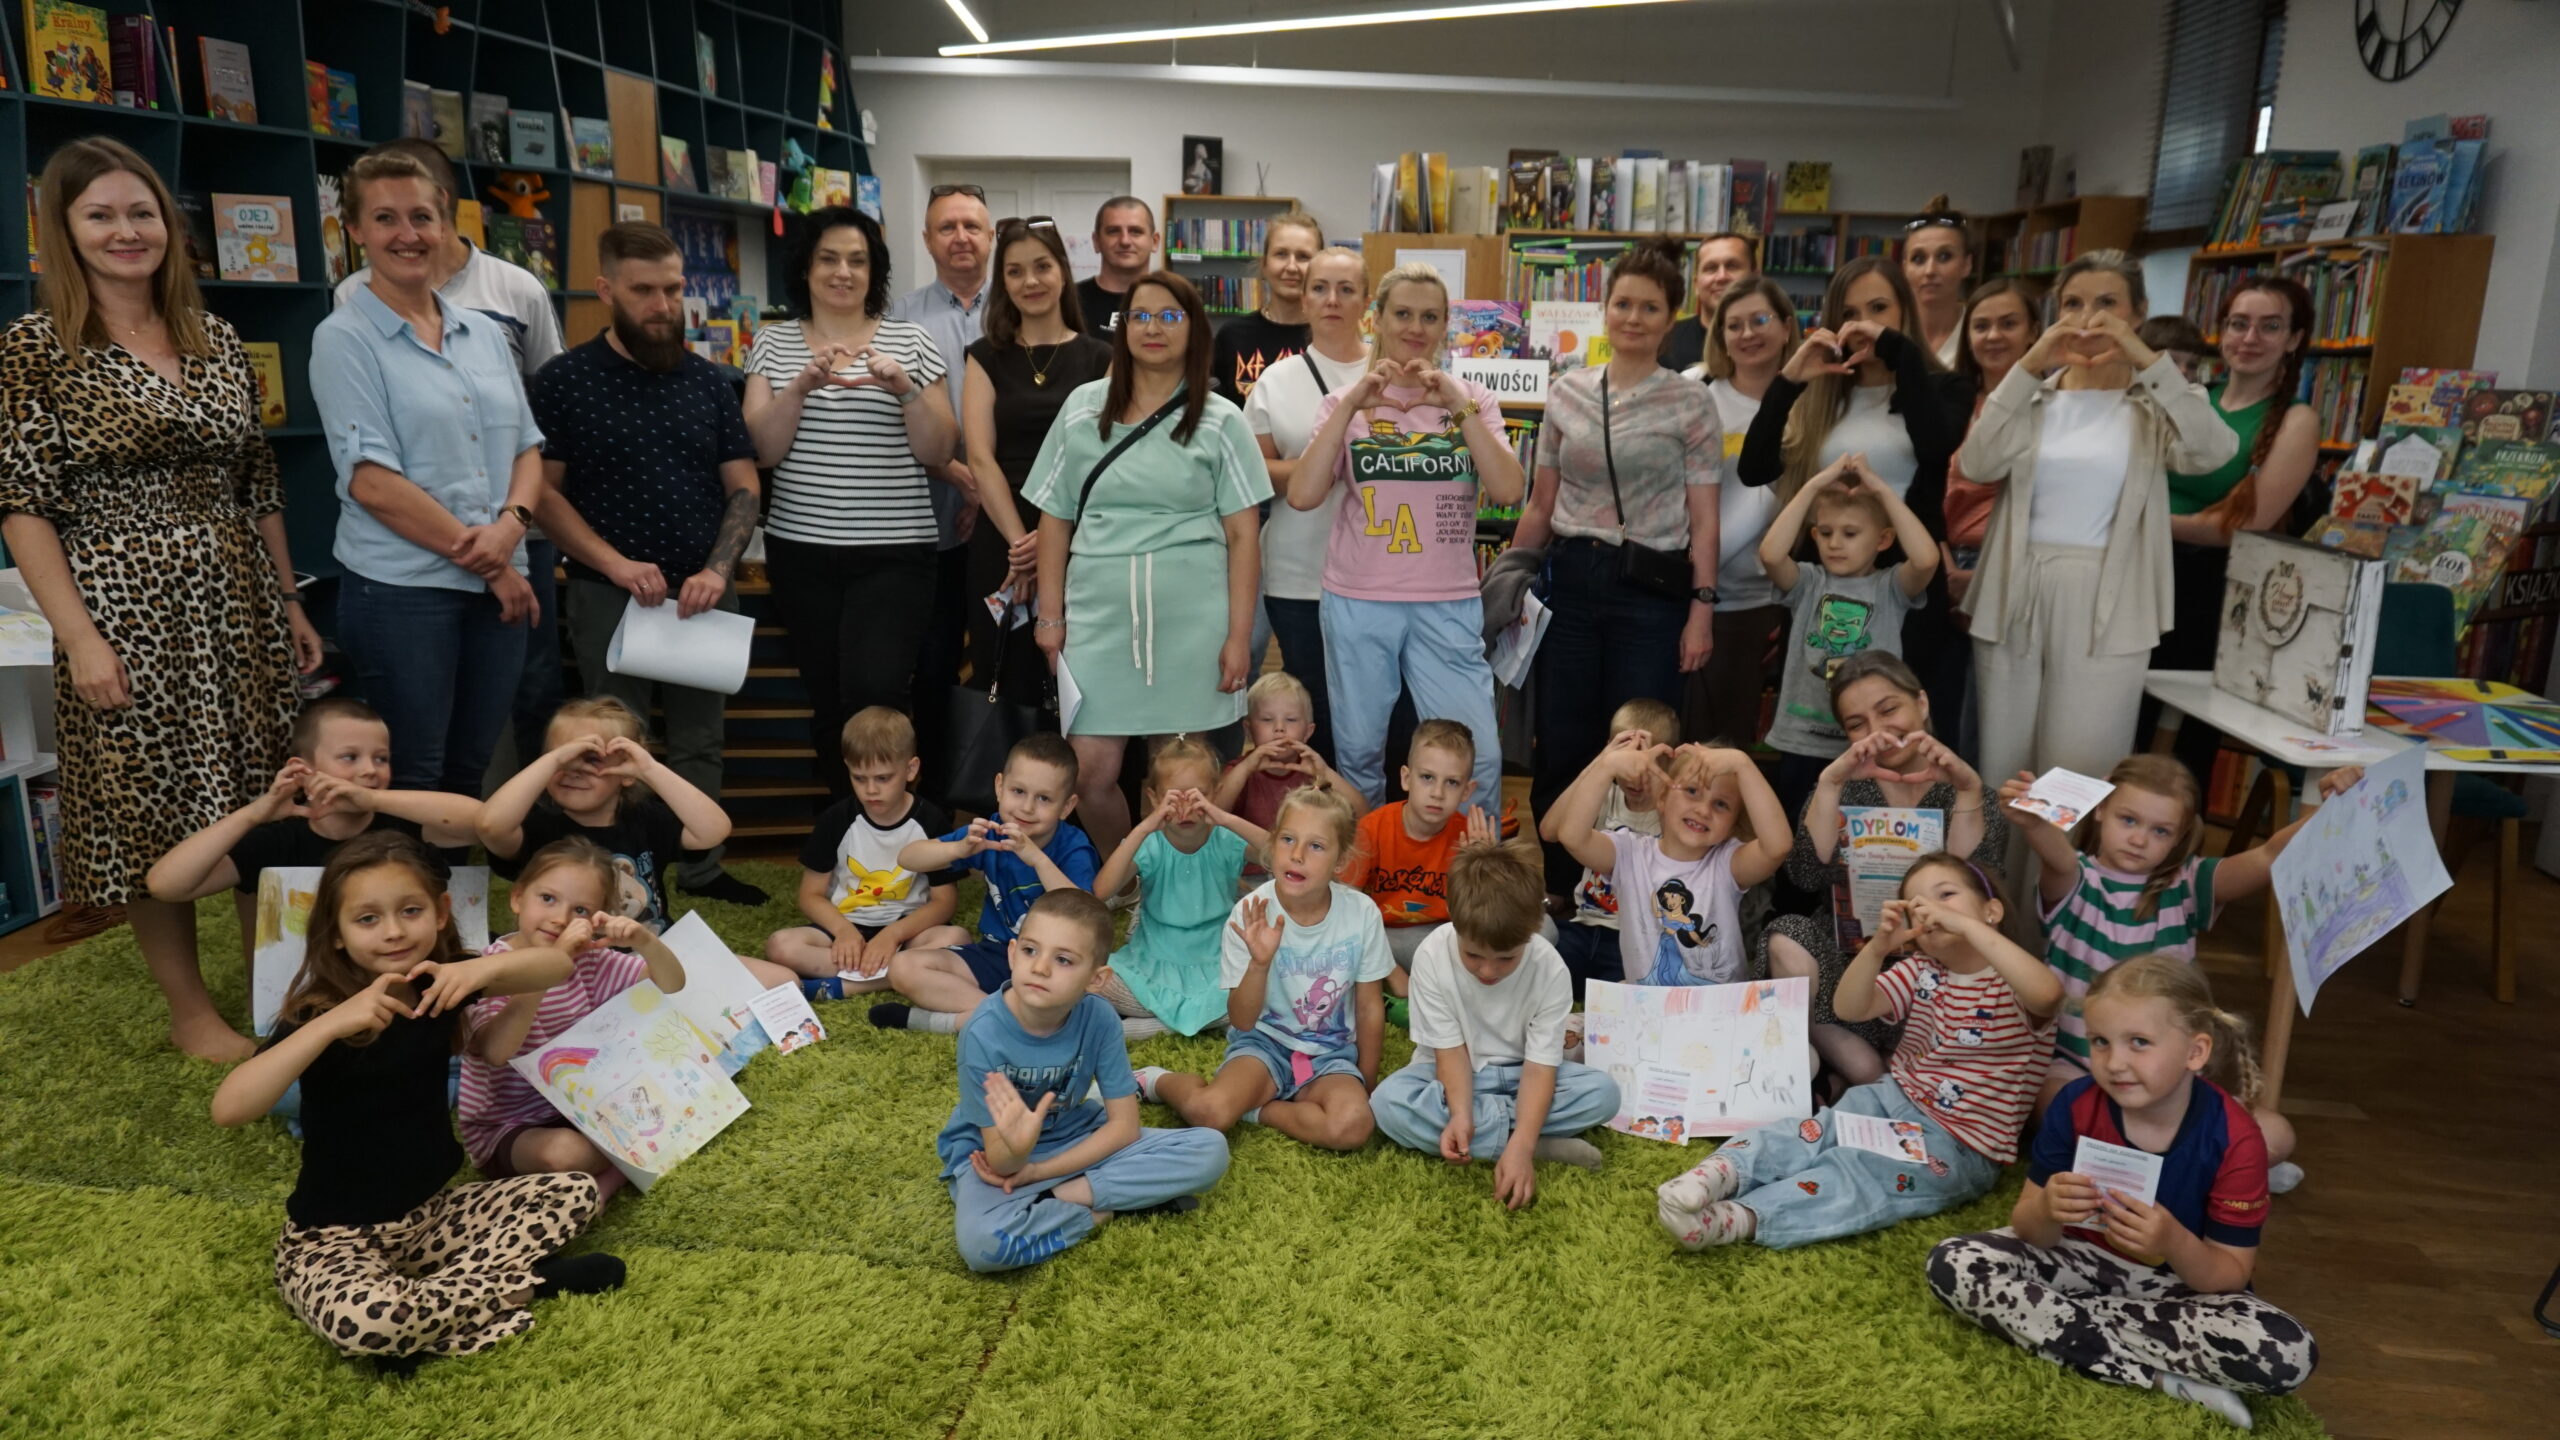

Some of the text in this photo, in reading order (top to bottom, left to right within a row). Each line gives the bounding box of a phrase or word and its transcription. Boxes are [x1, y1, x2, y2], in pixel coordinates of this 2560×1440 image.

[1537, 308, 1599, 319] WARSZAWA
[1360, 452, 1474, 474] CALIFORNI
[1435, 502, 1454, 511] LIFE
[1435, 520, 1448, 528] GO
[1435, 528, 1469, 537] JOURNEY
[1435, 536, 1447, 544] OF
[2436, 555, 2468, 573] ROK
[1850, 818, 1921, 839] DYPLOM
[1278, 938, 1361, 978] Angel
